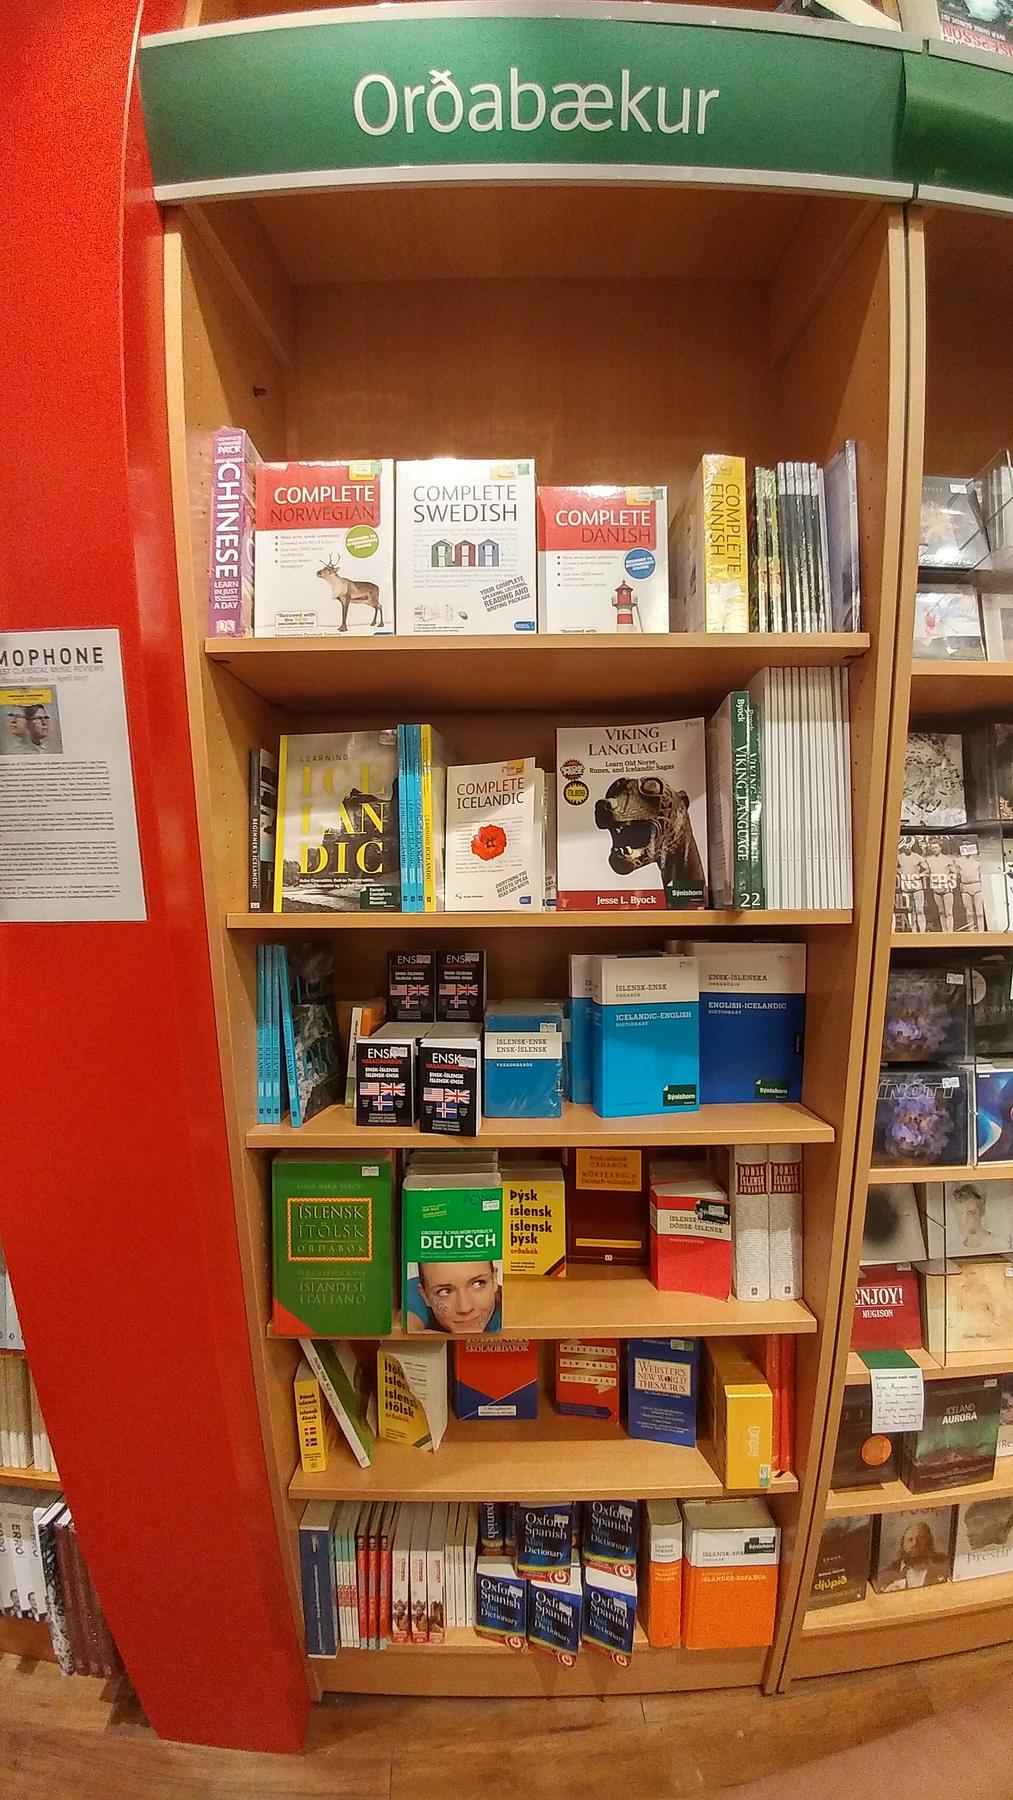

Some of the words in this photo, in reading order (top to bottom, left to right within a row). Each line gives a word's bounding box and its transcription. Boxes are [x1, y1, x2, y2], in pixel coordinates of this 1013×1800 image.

[353, 67, 720, 137] Orðabækur
[273, 485, 375, 504] COMPLETE
[413, 485, 516, 502] COMPLETE
[214, 463, 241, 579] CHINESE
[270, 505, 375, 524] NORWEGIAN
[413, 503, 517, 523] SWEDISH
[555, 509, 651, 526] COMPLETE
[710, 483, 726, 557] FINNISH
[581, 527, 651, 544] DANISH
[724, 483, 743, 574] COMPLETE
[480, 585, 495, 596] YOUR
[495, 576, 525, 592] COMPLETE
[484, 593, 514, 607] READING
[514, 587, 529, 599] AND
[736, 698, 745, 723] Byock
[605, 726, 660, 741] VIKING
[588, 740, 668, 757] LANGUAGE
[670, 738, 677, 751] 1
[300, 754, 349, 763] LEARNING
[735, 744, 750, 790] VIKING
[625, 765, 655, 773] Icelandic
[655, 764, 675, 772] Sagas
[456, 777, 525, 796] COMPLETE
[456, 791, 525, 810] ICELANDIC
[736, 791, 750, 862] LANGUAGE
[596, 895, 618, 905] Jesse
[620, 896, 629, 905] L.
[630, 895, 657, 905] Byock
[397, 955, 417, 965] ENS
[708, 1001, 787, 1010] ENGLISH-ICELANDIC
[615, 1011, 692, 1022] ICELANDIC-ENGLISH
[432, 1053, 462, 1065] ENSK
[420, 1233, 496, 1249] DEUTSCH
[862, 1308, 894, 1319] MUGISON
[638, 1360, 687, 1377] WEBSTER'S
[638, 1371, 657, 1382] NEW
[657, 1374, 687, 1385] WORLD
[639, 1379, 687, 1393] THESAURUS
[941, 1411, 978, 1425] AURORA
[485, 1502, 500, 1539] panish
[591, 1513, 633, 1535] Spanish
[525, 1524, 567, 1541] Spanish
[524, 1545, 565, 1560] Dictionary
[590, 1533, 631, 1554] Dictionary
[480, 1579, 514, 1598] Oxfo
[481, 1589, 522, 1610] Spanish
[480, 1608, 520, 1627] Dictionary
[535, 1601, 575, 1629] Spanish
[590, 1601, 630, 1630] Spanish
[534, 1620, 571, 1645] Dictionary
[589, 1619, 626, 1645] Dictionary
